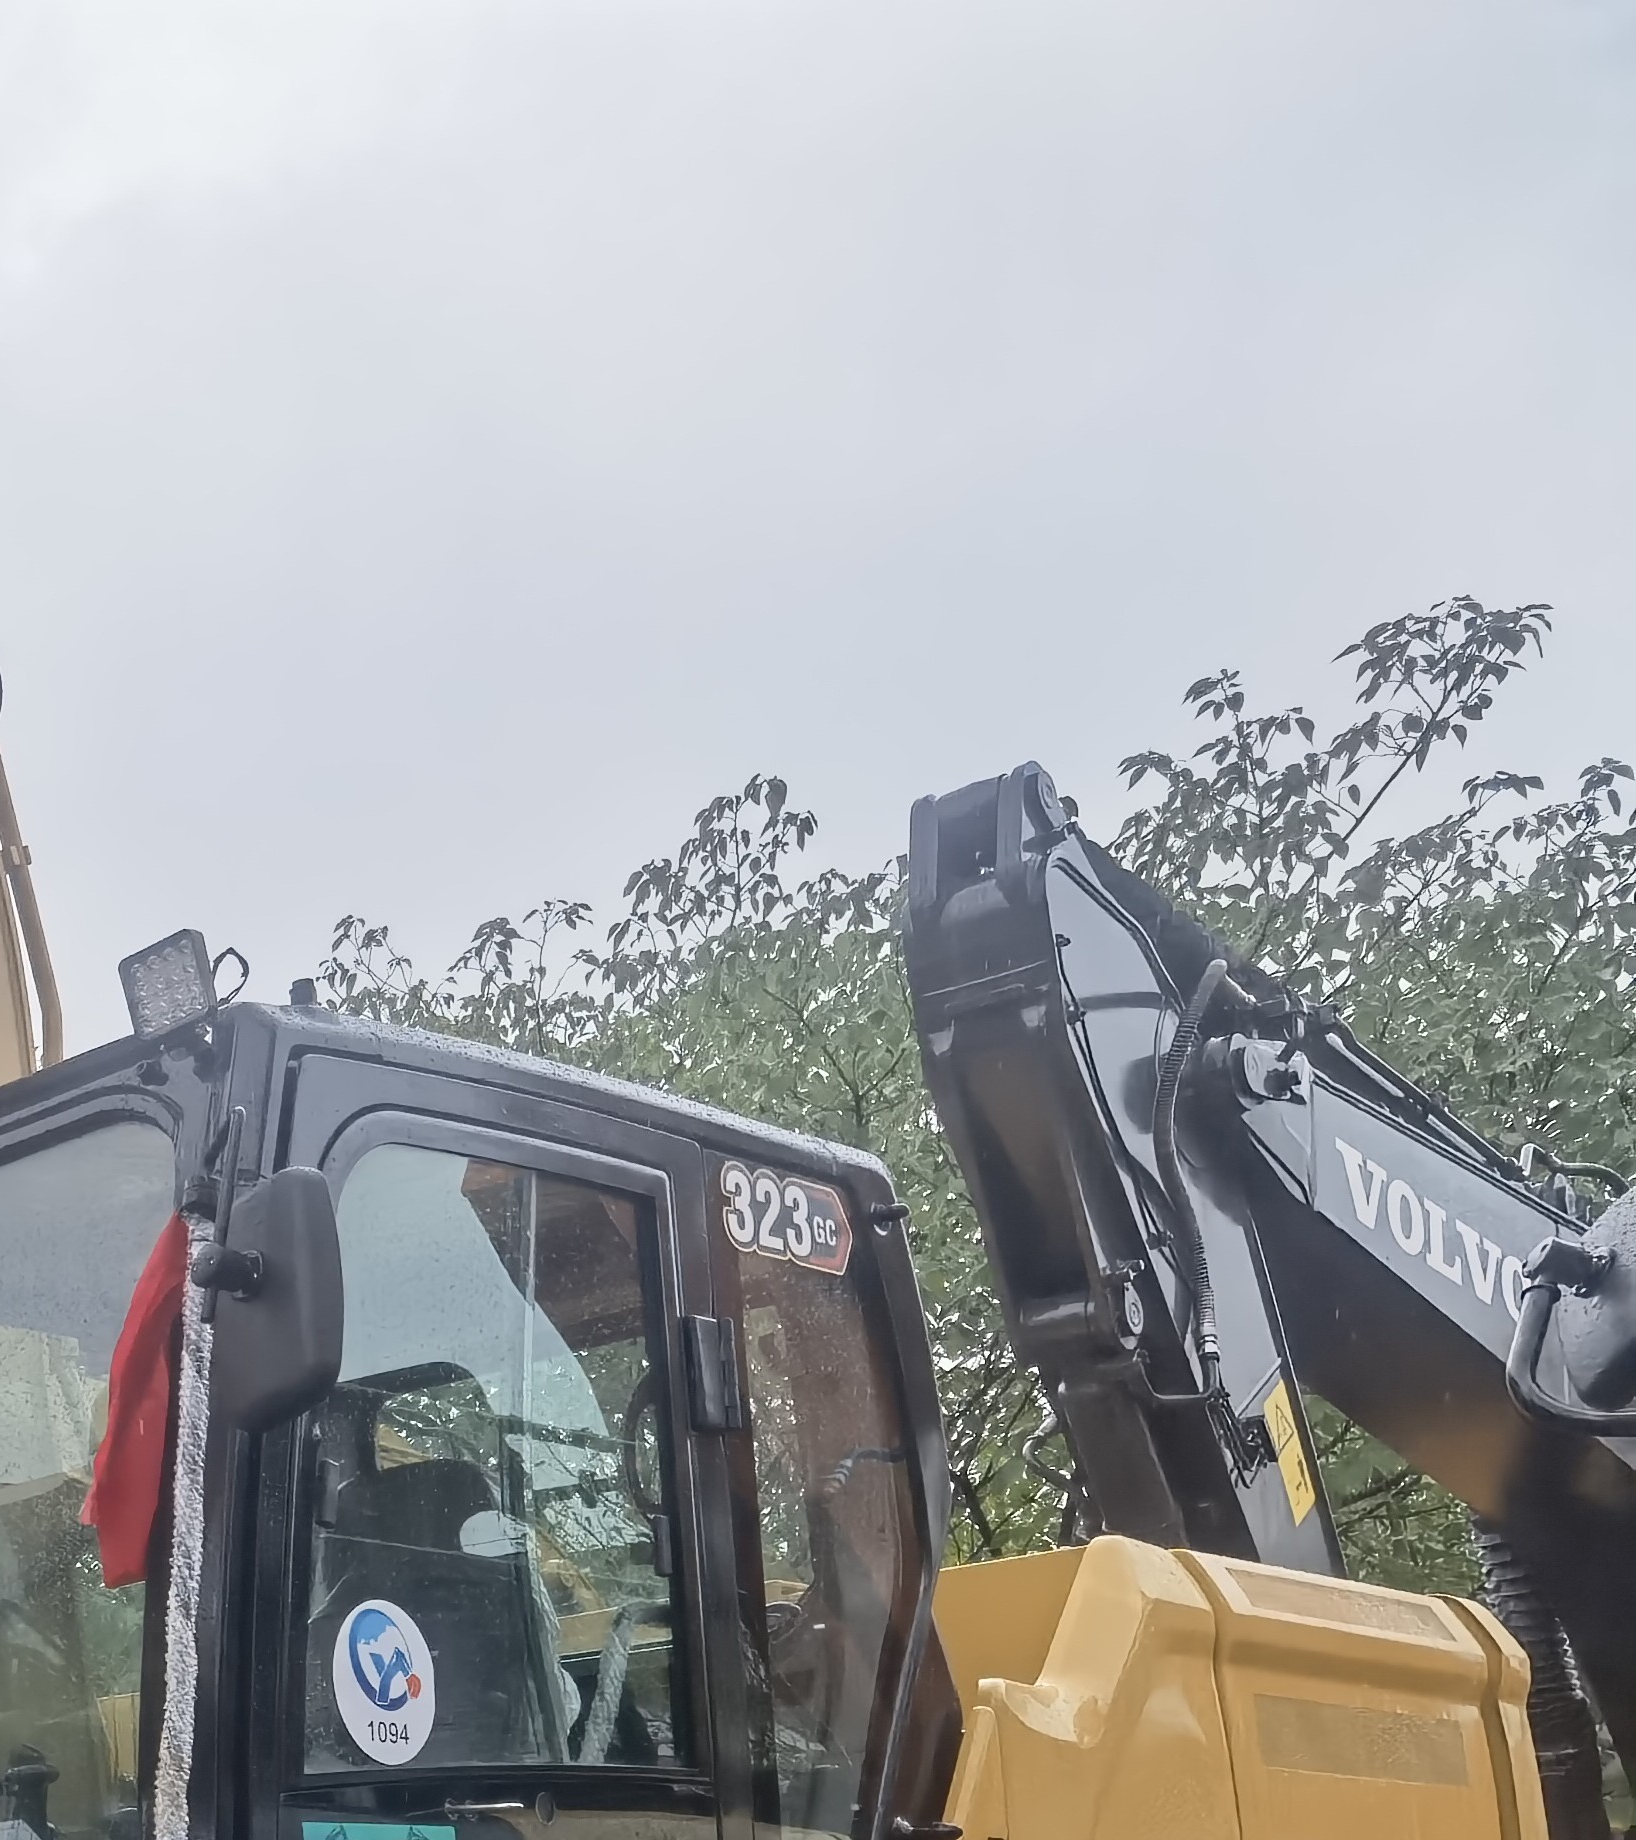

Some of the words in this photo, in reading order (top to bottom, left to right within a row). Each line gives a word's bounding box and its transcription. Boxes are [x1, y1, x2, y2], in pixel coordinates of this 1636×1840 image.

[725, 1170, 812, 1257] 323
[813, 1215, 837, 1246] GC
[1335, 1137, 1532, 1323] VOLVO
[367, 1720, 410, 1745] 1094
